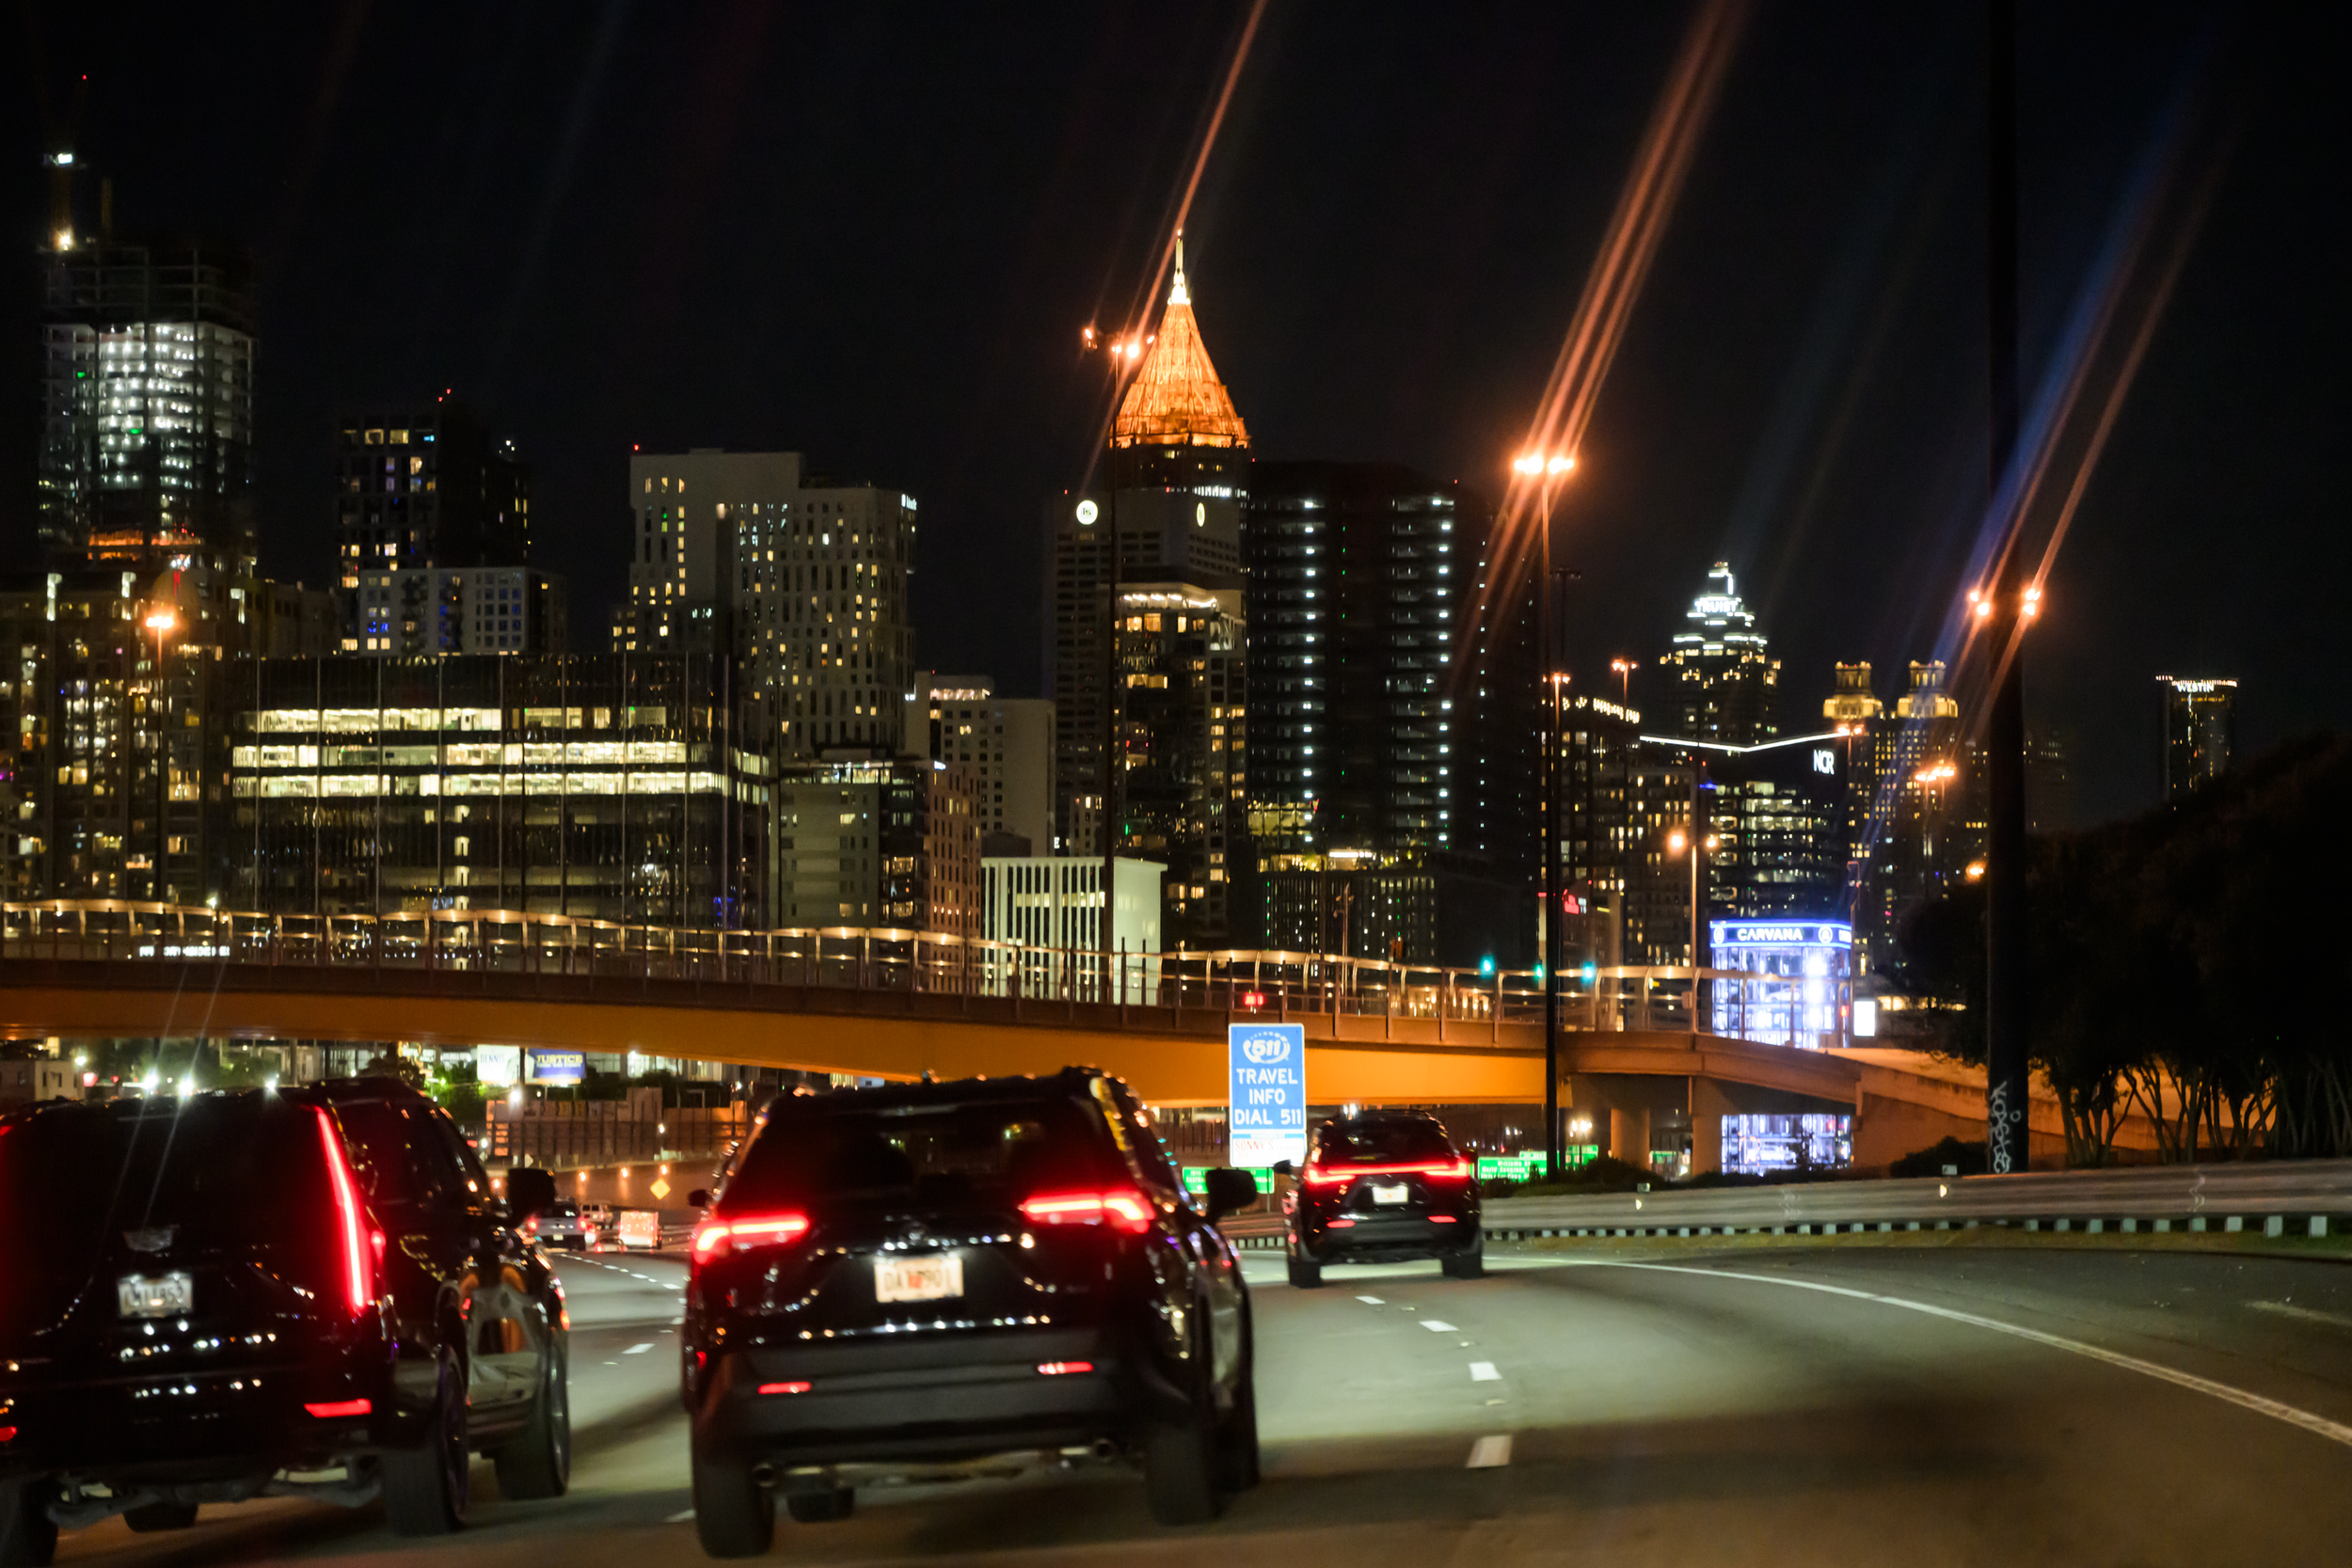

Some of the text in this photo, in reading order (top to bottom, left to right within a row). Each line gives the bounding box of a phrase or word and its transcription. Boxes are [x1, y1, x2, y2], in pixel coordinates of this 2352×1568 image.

[1694, 600, 1738, 612] TRUIST
[2177, 682, 2214, 692] WESTIN
[1813, 749, 1835, 775] NCR
[1737, 927, 1803, 941] CARVANA
[1251, 1039, 1281, 1056] 511
[480, 1053, 505, 1064] DENNIS
[536, 1054, 583, 1064] JUSTICE
[1236, 1068, 1298, 1085] TRAVEL
[1248, 1088, 1286, 1105] INFO
[1234, 1108, 1301, 1125] DIAL 511
